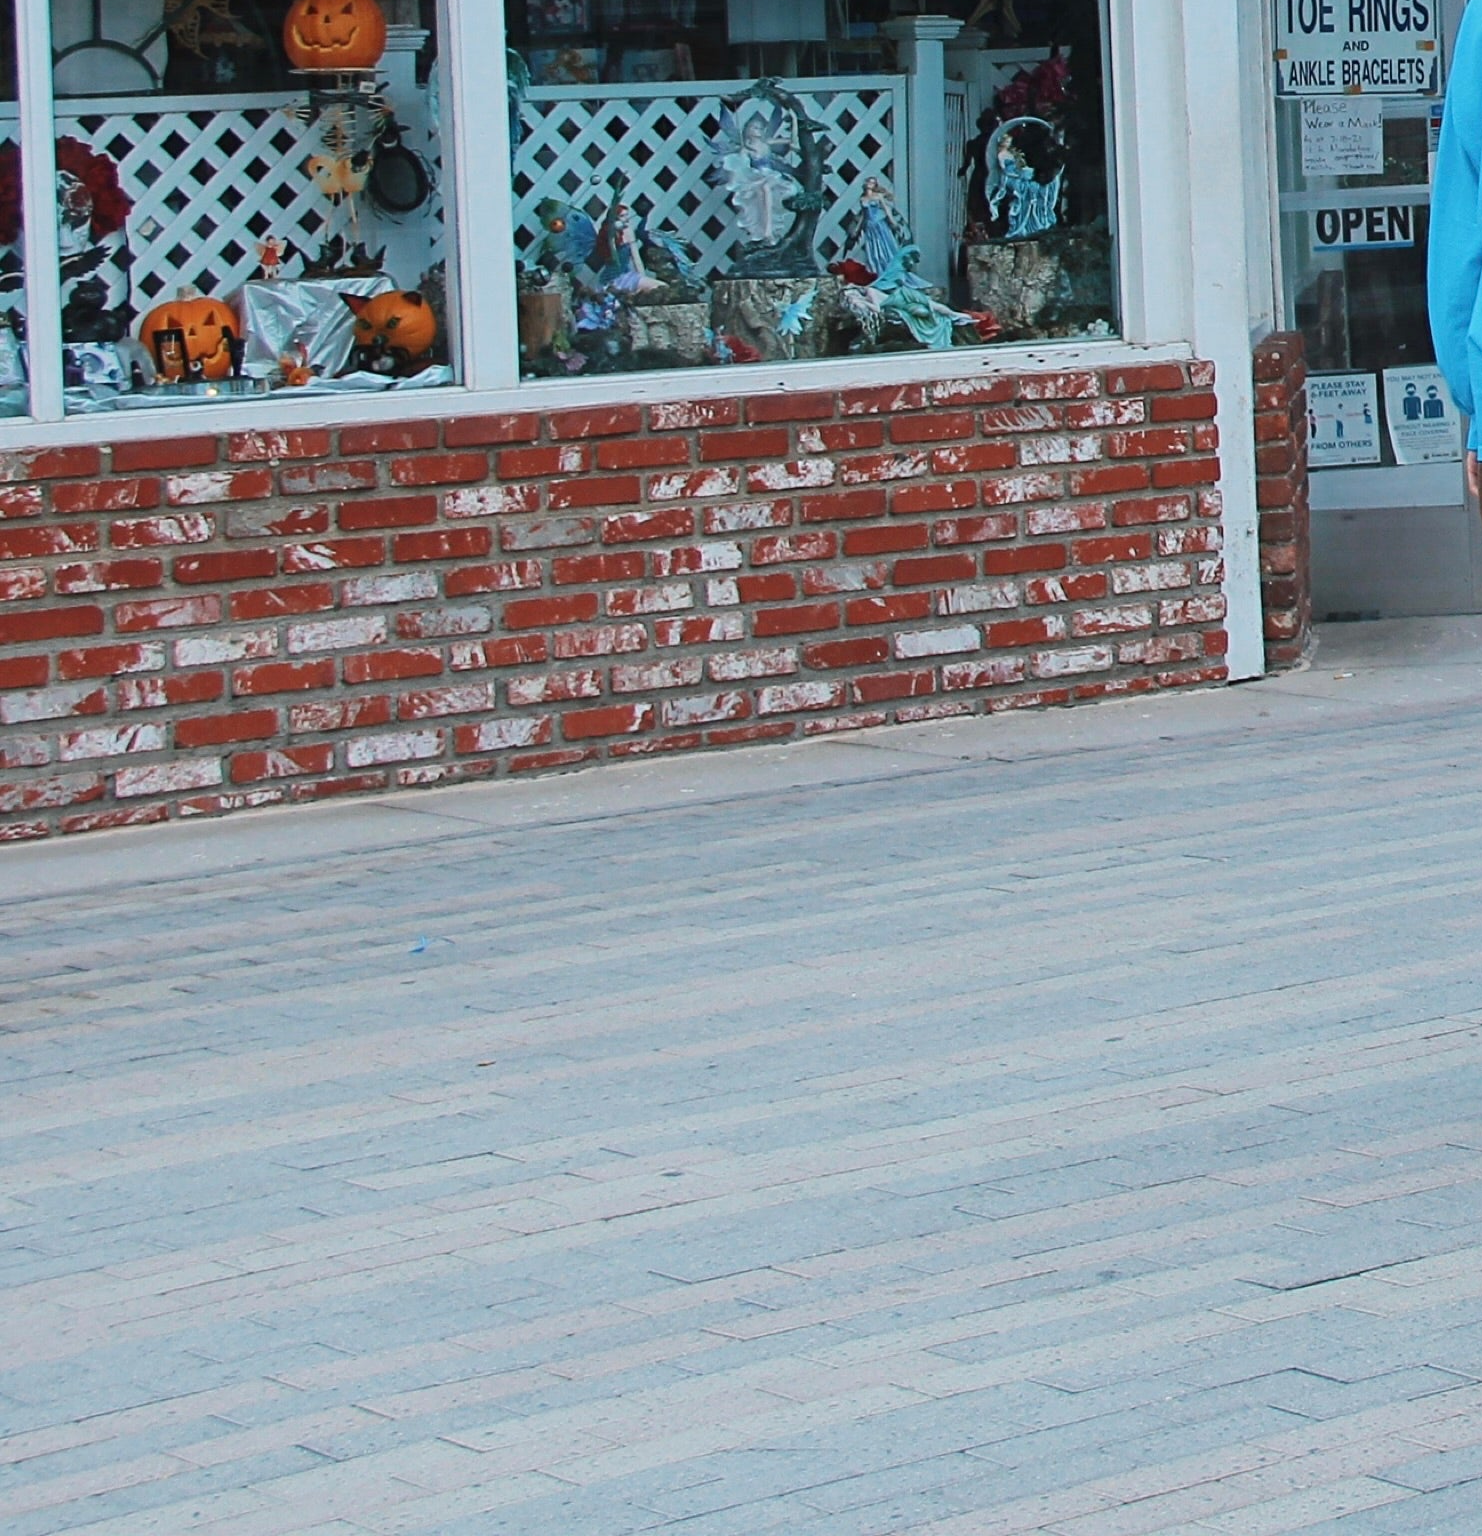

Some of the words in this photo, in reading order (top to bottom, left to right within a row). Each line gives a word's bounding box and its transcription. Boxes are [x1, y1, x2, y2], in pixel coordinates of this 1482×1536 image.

[1342, 40, 1369, 52] AND
[1288, 60, 1336, 86] ANKLE
[1341, 58, 1426, 86] BRACELETS
[1302, 100, 1347, 114] Please
[1315, 205, 1411, 245] OPEN
[1310, 381, 1343, 391] PLEASE
[1345, 380, 1366, 389] STAY
[1341, 388, 1367, 397] AWAY
[1310, 441, 1337, 451] FROM
[1338, 440, 1373, 450] OTHERS
